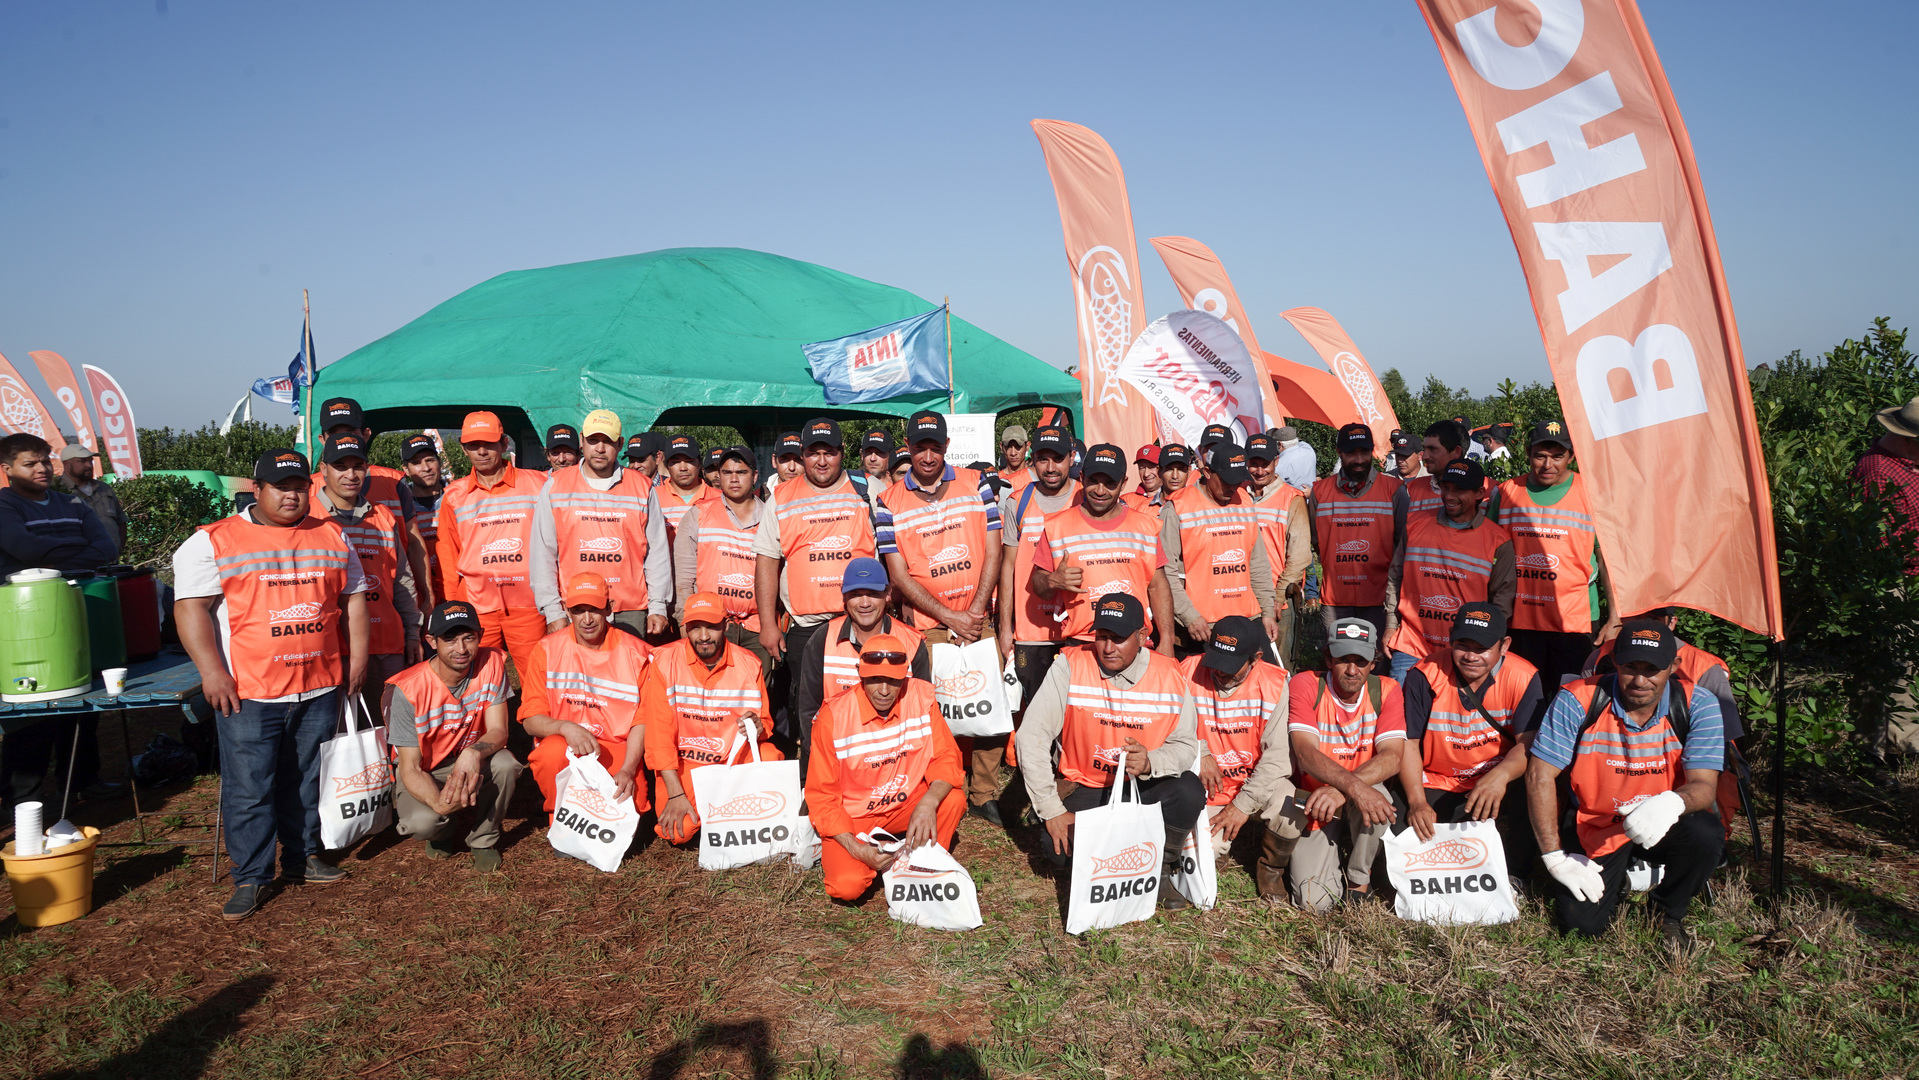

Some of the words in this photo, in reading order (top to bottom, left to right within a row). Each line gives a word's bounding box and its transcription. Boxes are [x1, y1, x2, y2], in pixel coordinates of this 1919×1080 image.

[482, 554, 523, 564] BAHCO
[580, 553, 622, 562] BAHCO
[809, 551, 852, 562] BAHCO
[1336, 554, 1369, 562] BAHCO
[931, 560, 971, 578] BAHCO
[1213, 564, 1246, 575] BAHCO
[1516, 569, 1557, 581] BAHCO
[259, 573, 296, 581] CONCURSO
[718, 586, 753, 599] BAHCO
[1465, 619, 1488, 627] BAHCO
[272, 622, 324, 637] BAHCO
[555, 807, 616, 844] BAHCO
[708, 825, 789, 847] BAHCO
[1409, 873, 1497, 894] BAHCO
[892, 882, 960, 902] BAHCO
[1090, 876, 1157, 904] BAHCO
